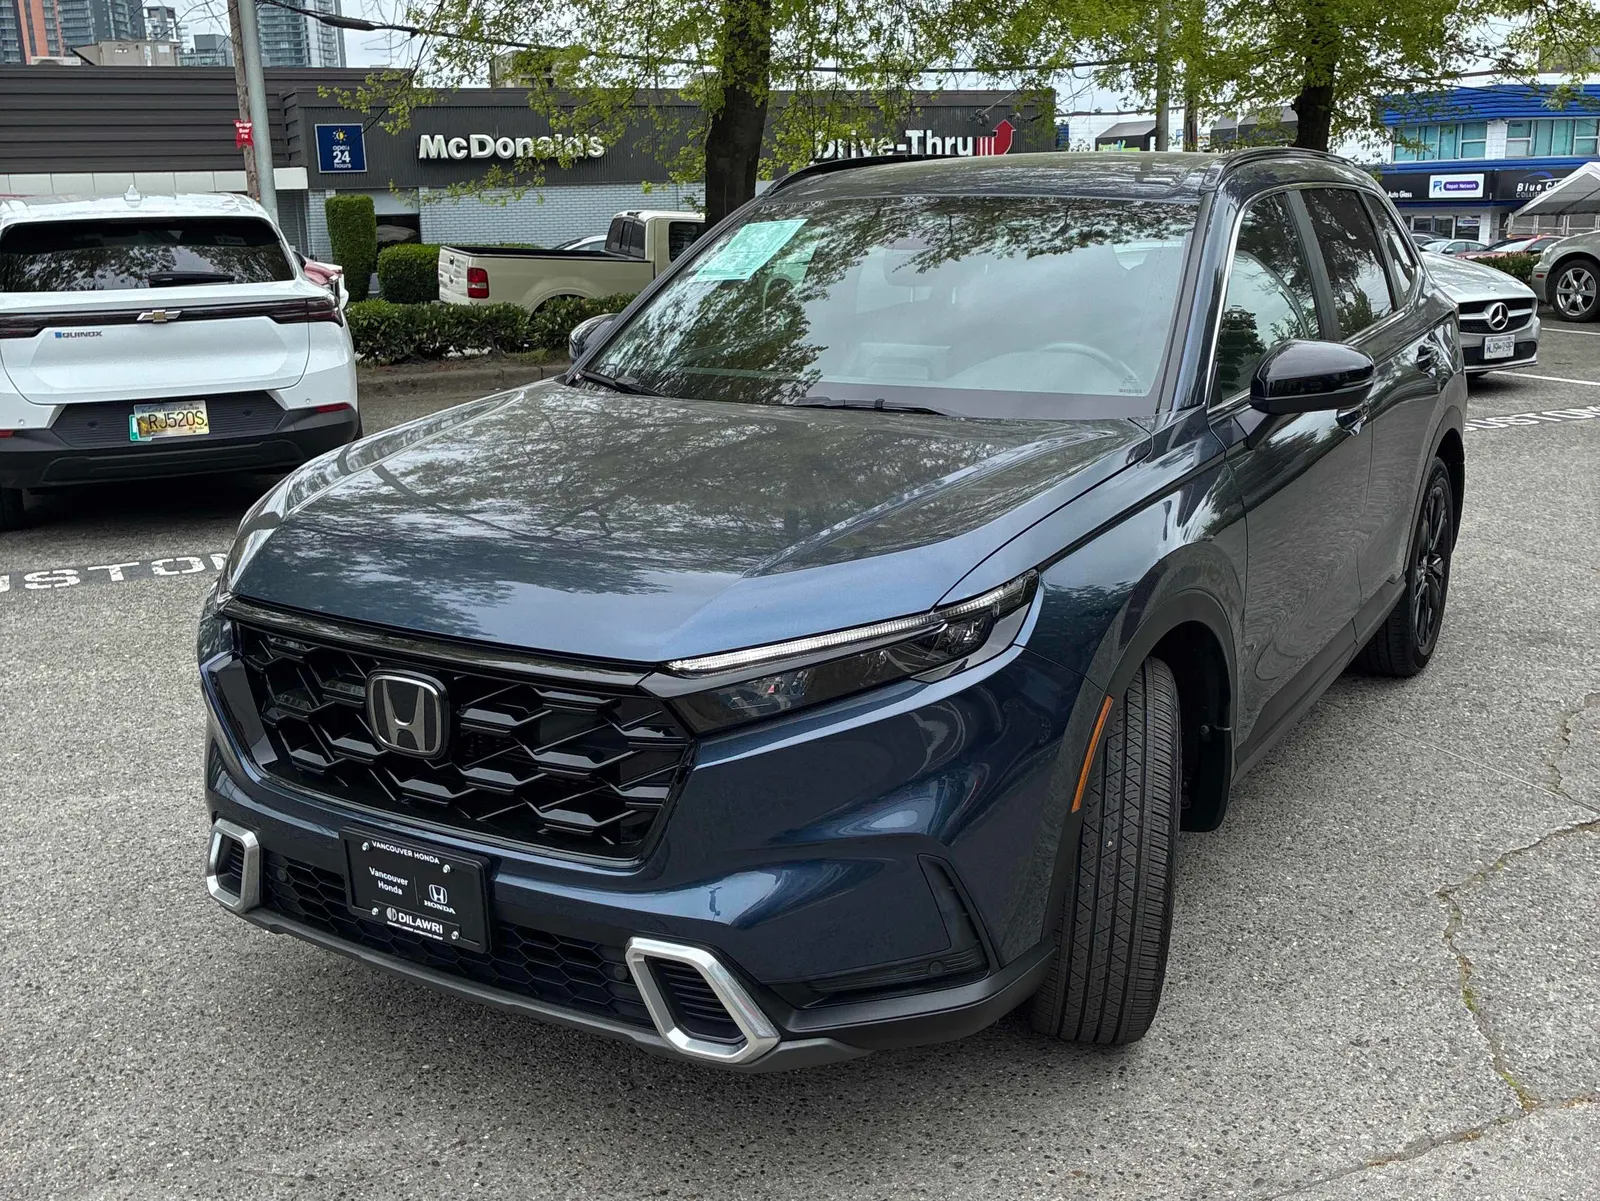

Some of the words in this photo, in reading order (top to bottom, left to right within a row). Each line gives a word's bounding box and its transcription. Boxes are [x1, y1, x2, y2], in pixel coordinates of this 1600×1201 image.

[332, 150, 351, 163] 24
[1388, 190, 1399, 198] Auto
[1400, 190, 1412, 198] Glass
[1516, 182, 1542, 192] Blue
[148, 411, 205, 430] RJ520S
[371, 840, 413, 858] VANCOUVER
[413, 851, 441, 865] HONDA
[368, 866, 409, 886] Vancouver
[377, 880, 403, 895] Honda
[423, 899, 457, 915] HONDA
[398, 912, 443, 934] DILAWRI
